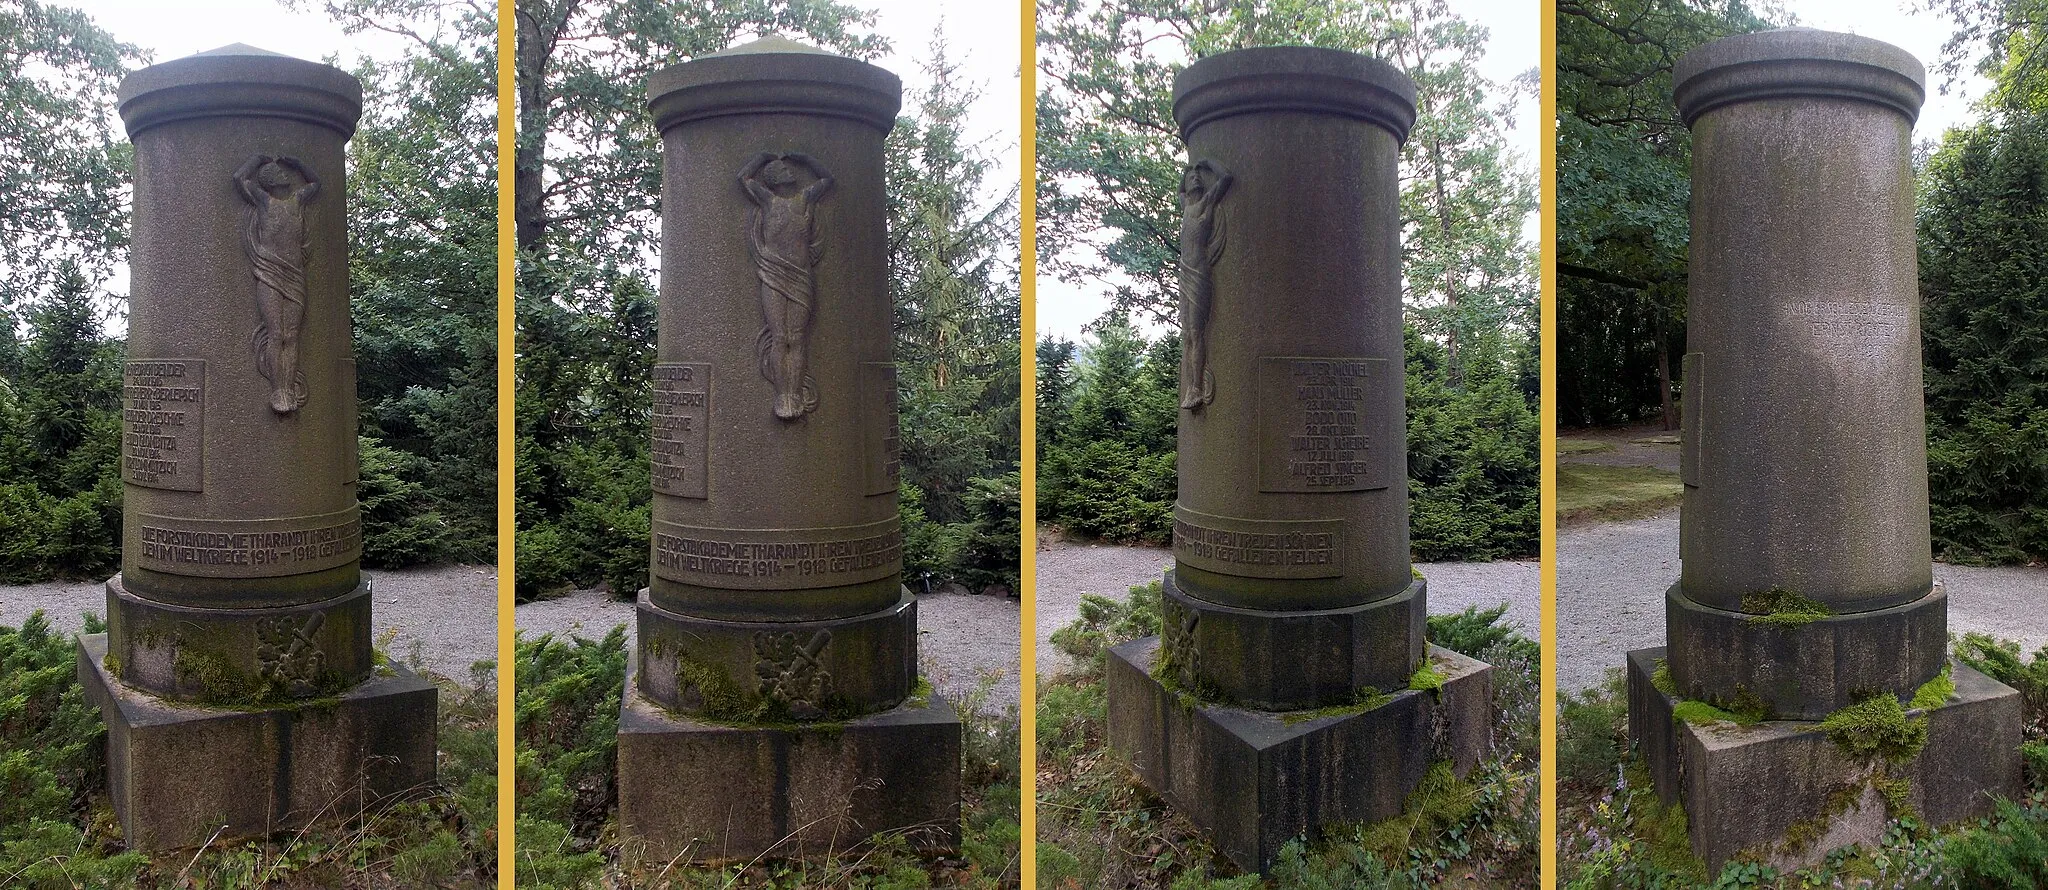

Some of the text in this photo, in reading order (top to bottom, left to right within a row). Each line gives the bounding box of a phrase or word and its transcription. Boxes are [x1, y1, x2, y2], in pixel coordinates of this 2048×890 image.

[154, 362, 186, 378] BENDER
[155, 387, 201, 403] BERLEPSCH
[1305, 410, 1358, 425] BODO OTTO
[1290, 435, 1331, 451] WALTER
[1292, 460, 1368, 476] ALFRED SINGER
[142, 525, 156, 542] DIE
[156, 527, 250, 549] FORSTAKADEMIE
[250, 530, 308, 549] THARANDT
[667, 534, 751, 559] FORSTAKADEMIE
[751, 542, 816, 559] THARANDT
[818, 539, 852, 558] IHREN
[1208, 528, 1237, 547] IHREN
[1238, 531, 1283, 549] TREUEN
[1284, 530, 1334, 550] SÖHNEN
[142, 540, 158, 559] DEN
[159, 543, 172, 561] IM
[174, 545, 249, 565] WELTKRIEGE
[250, 548, 278, 564] 1914
[292, 545, 316, 561] 1918
[669, 550, 681, 570] IM
[682, 553, 750, 575] WELTKRIEGE
[751, 558, 782, 576] 1914
[797, 558, 826, 575] 1918
[1193, 541, 1214, 559] 1918
[1215, 545, 1283, 566] GEFALLENEN
[1285, 549, 1334, 565] HELDEN
